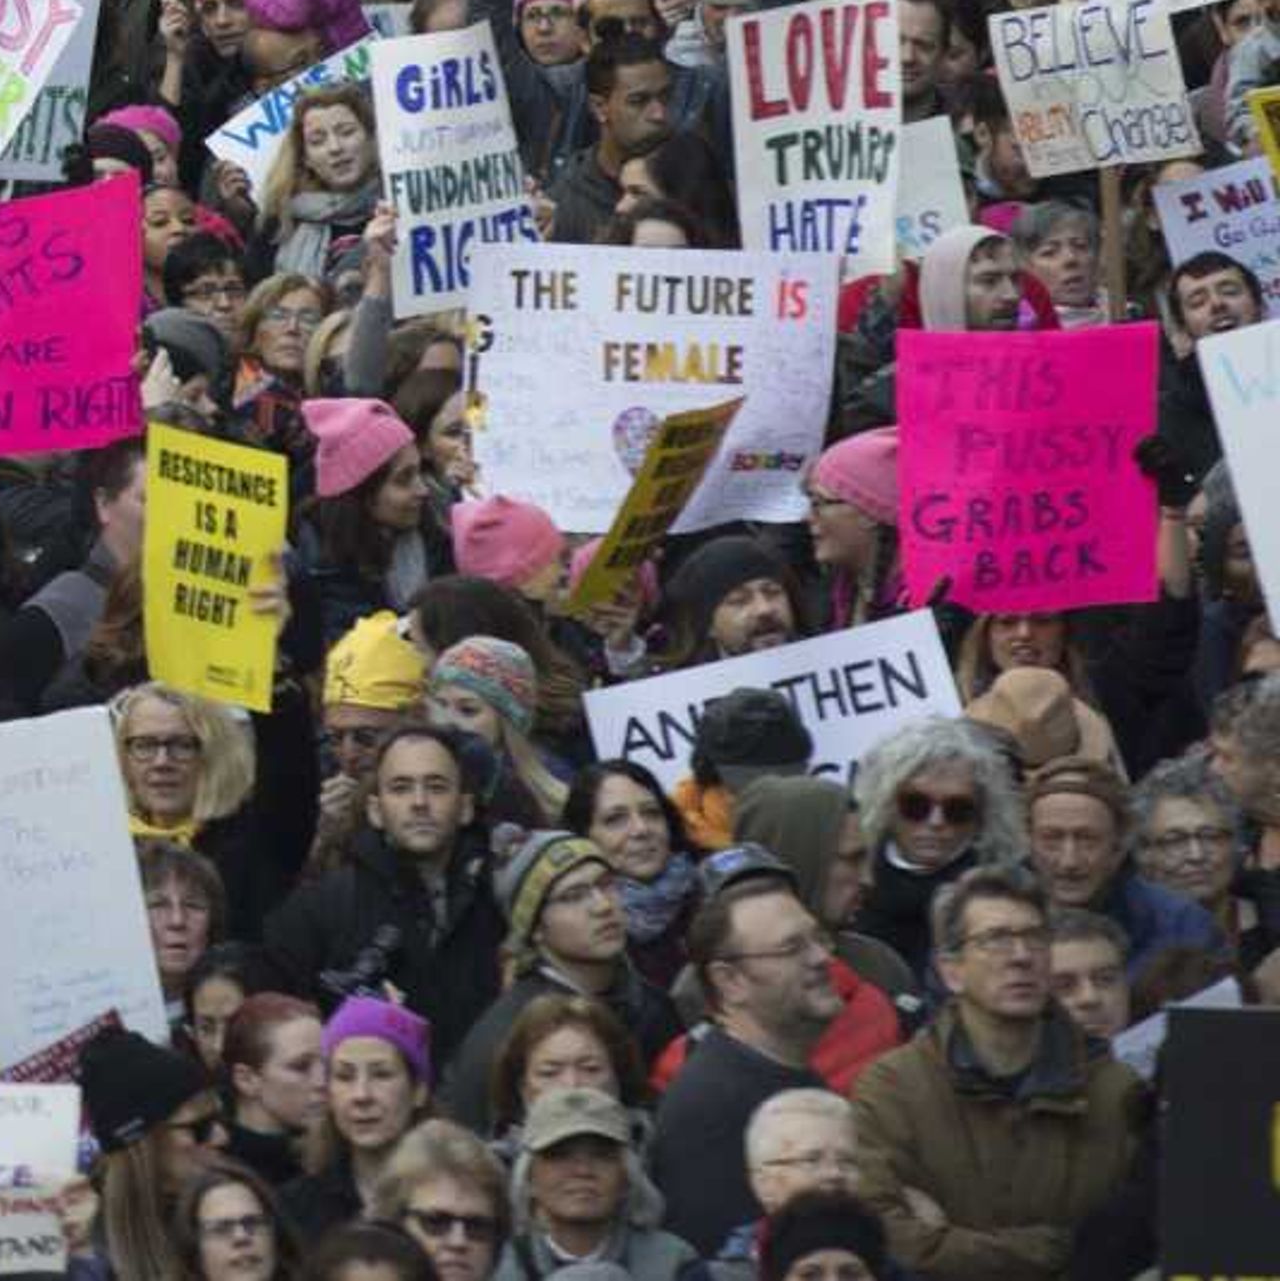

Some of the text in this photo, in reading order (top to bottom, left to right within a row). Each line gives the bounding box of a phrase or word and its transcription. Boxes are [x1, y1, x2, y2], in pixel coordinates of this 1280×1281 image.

[742, 1, 896, 121] LOVE
[765, 123, 897, 185] TRUMPS
[389, 149, 525, 216] FUNDAMEN
[768, 194, 868, 254] HATE
[510, 269, 809, 319] THE FUTURE IS
[603, 342, 745, 385] FEMALE
[920, 351, 1064, 410] THIS
[954, 423, 1128, 476] PUSSY
[157, 448, 278, 508] RESISTANCE
[194, 500, 239, 542] IS A
[912, 489, 1091, 544] GRABS
[173, 539, 252, 586] HUMAN
[973, 544, 1107, 594] BACK
[173, 583, 240, 631] RIGHT
[773, 651, 930, 716] THEN
